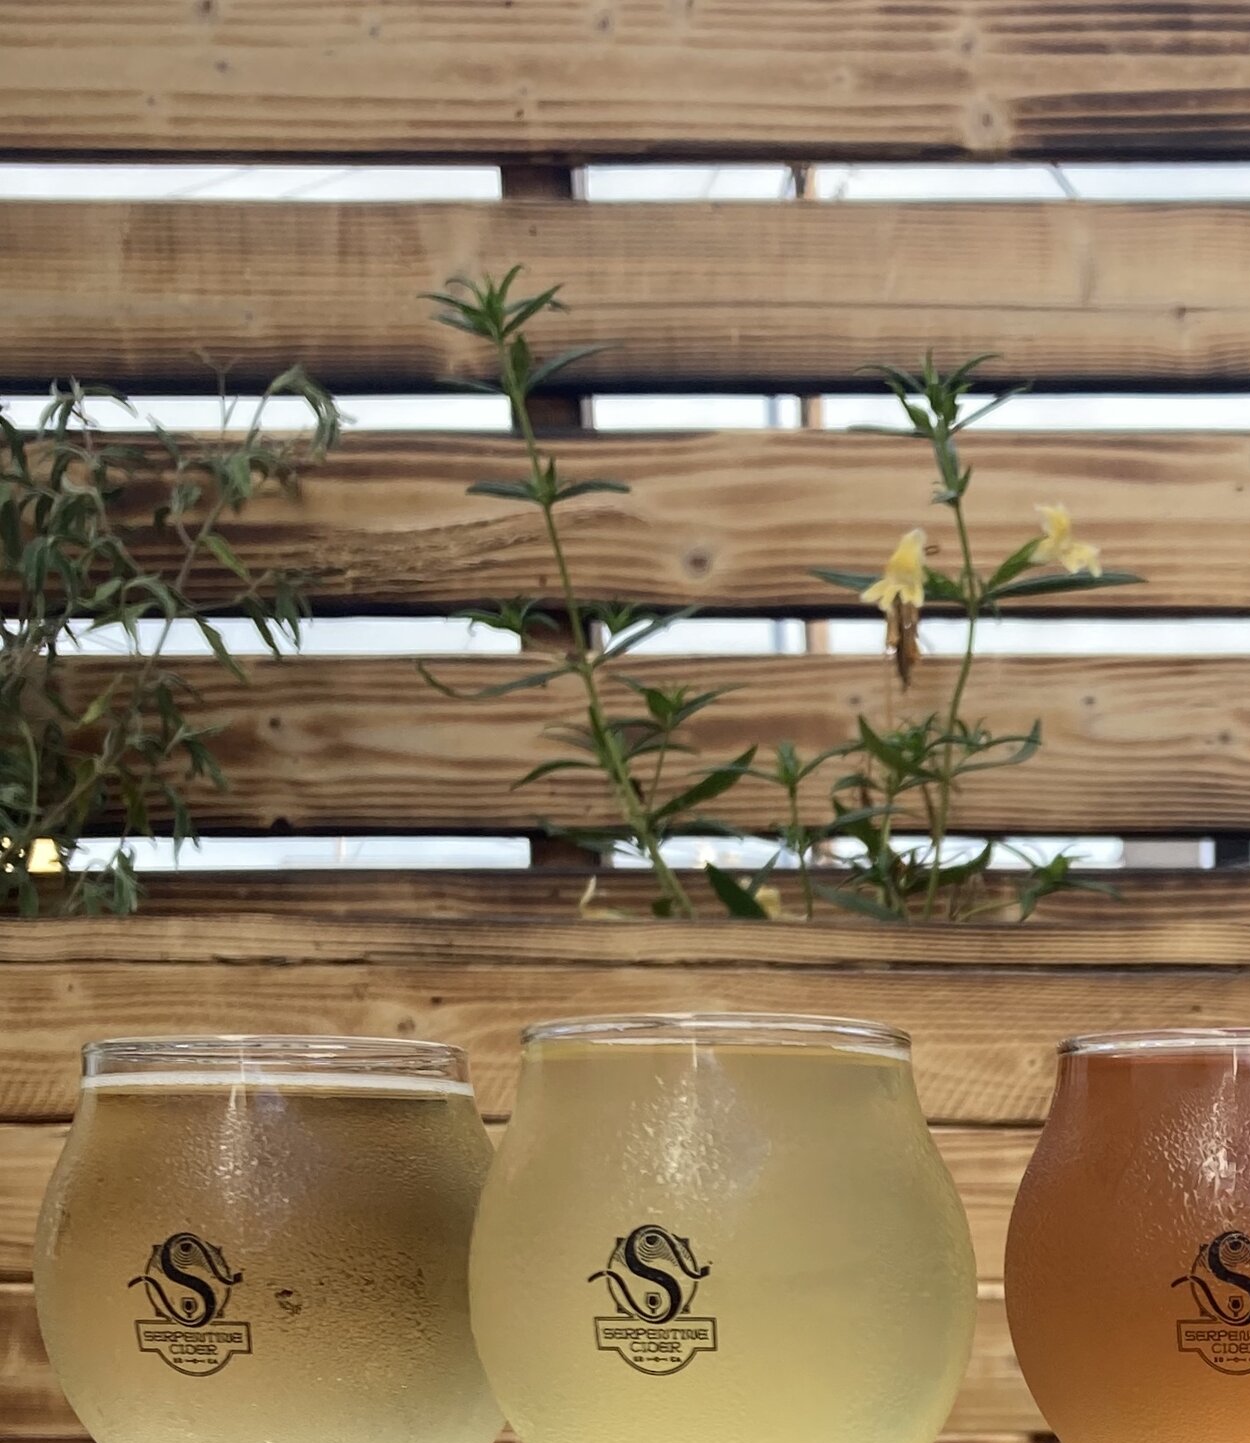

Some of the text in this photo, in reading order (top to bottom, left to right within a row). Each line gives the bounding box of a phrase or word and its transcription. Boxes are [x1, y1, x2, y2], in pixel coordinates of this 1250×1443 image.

[143, 1331, 243, 1343] SERPENTINE
[603, 1328, 709, 1340] SERPENTINE
[169, 1344, 218, 1355] CIDER
[630, 1341, 682, 1353] CIDER
